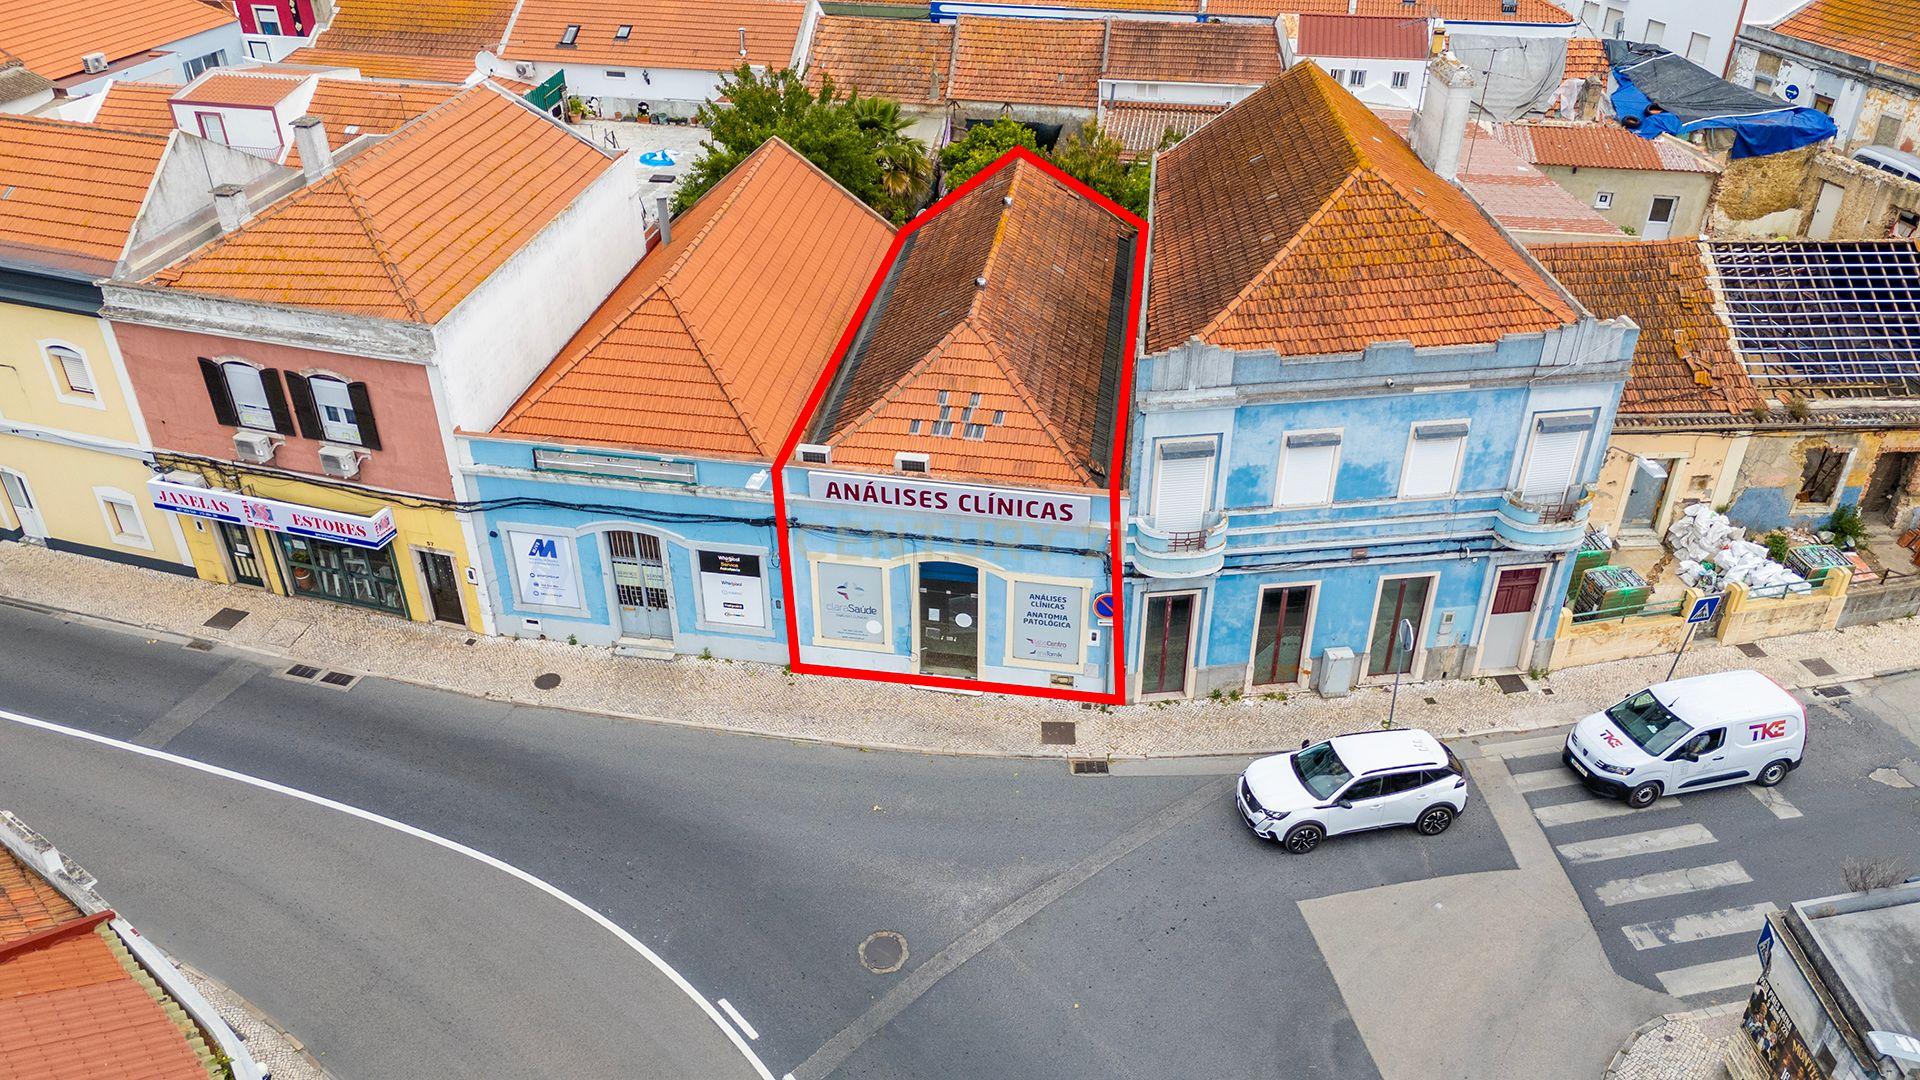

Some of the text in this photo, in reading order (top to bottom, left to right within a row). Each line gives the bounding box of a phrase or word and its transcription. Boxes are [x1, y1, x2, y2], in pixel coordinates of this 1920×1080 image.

[159, 490, 230, 513] JANELAS
[825, 481, 1074, 522] ANÁLISES CLÍNICAS
[291, 513, 367, 537] ESTORES
[1029, 593, 1067, 604] ANÁLISES
[1030, 600, 1065, 610] CLÍNICAS
[1023, 618, 1070, 627] PATOLÓGICA
[1026, 611, 1068, 621] ANATOMIA
[1600, 729, 1623, 748] TKE
[1748, 719, 1787, 742] TKE
